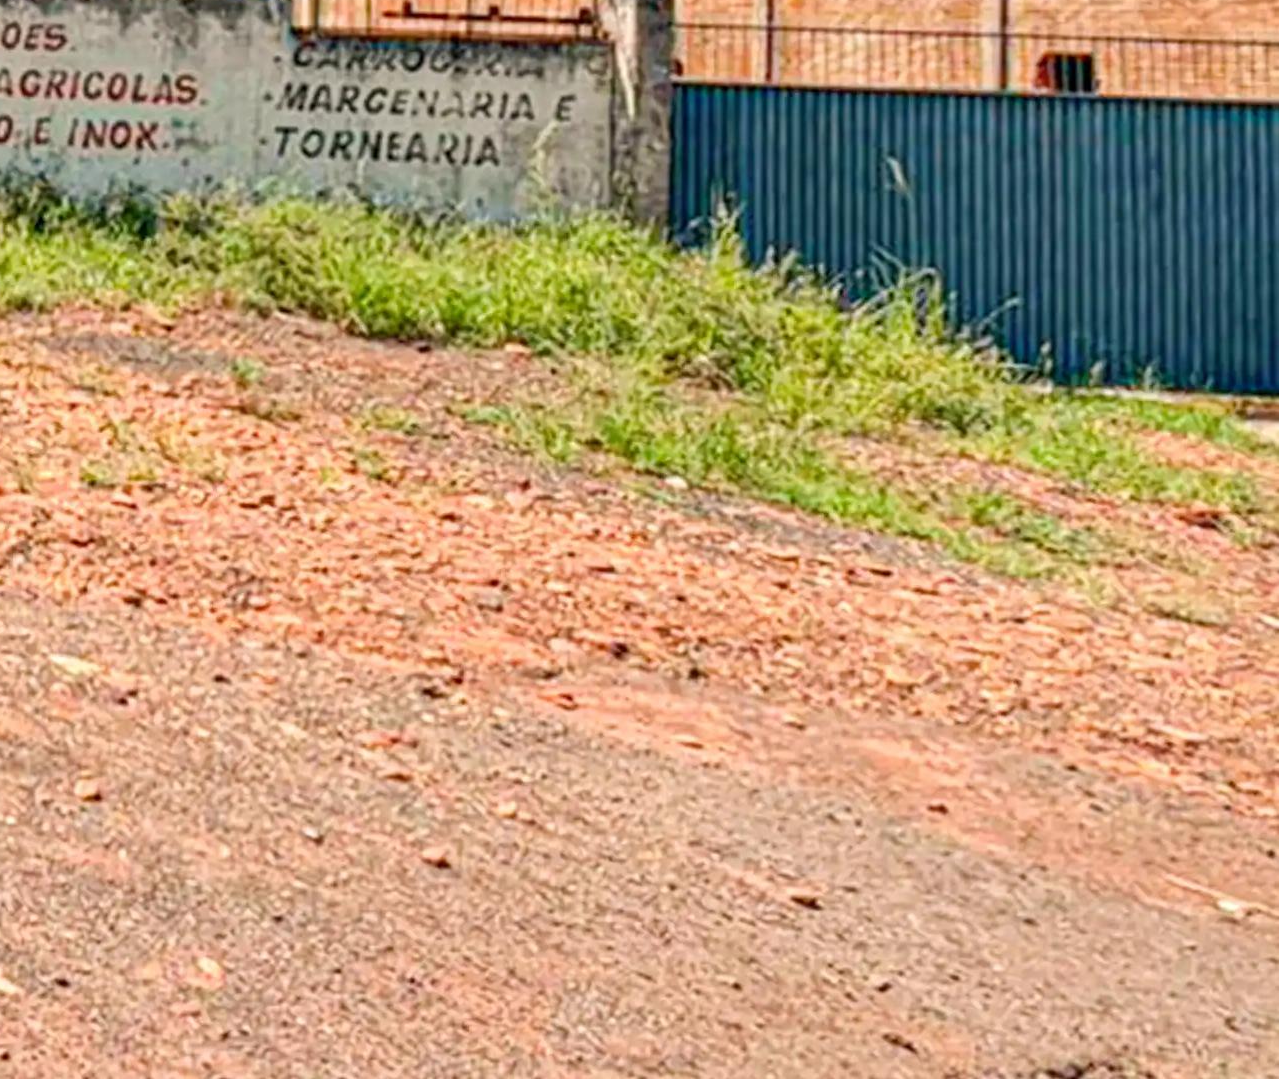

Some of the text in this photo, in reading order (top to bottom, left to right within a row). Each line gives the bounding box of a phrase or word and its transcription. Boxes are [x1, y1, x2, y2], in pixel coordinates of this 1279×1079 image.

[554, 94, 578, 122] E
[33, 117, 52, 146] E
[275, 125, 501, 167] TORNEARIA
